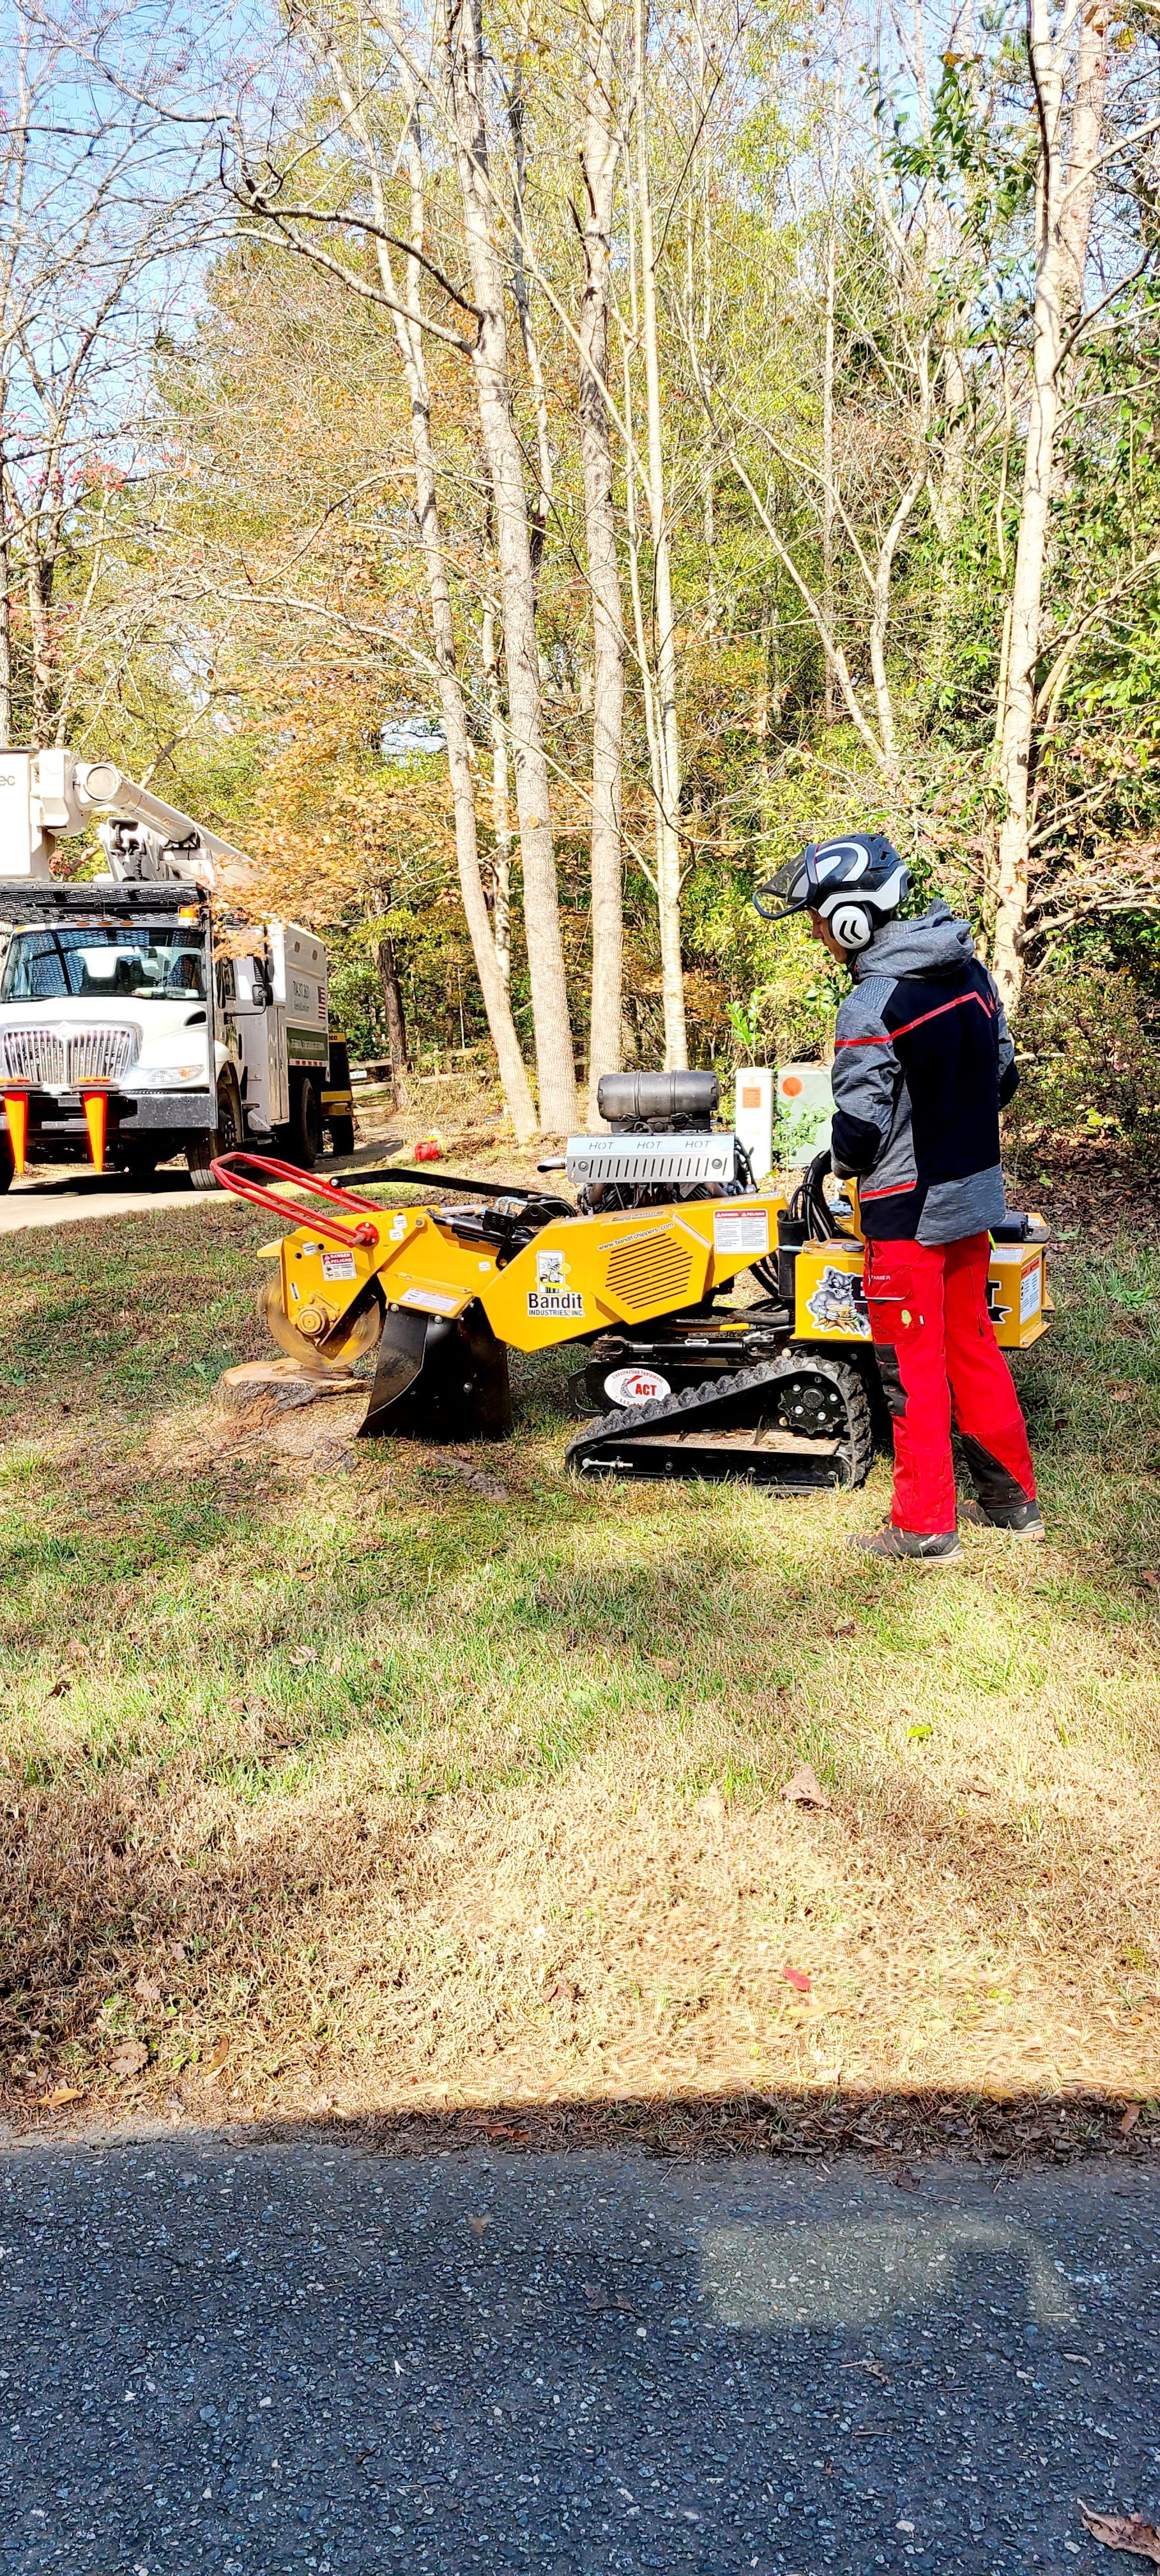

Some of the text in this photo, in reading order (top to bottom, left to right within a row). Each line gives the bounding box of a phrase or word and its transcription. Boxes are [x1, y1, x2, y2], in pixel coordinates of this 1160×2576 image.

[588, 1140, 712, 1150] HOT HOT HOT
[528, 1292, 583, 1308] Bandit
[635, 1383, 657, 1396] ACT
